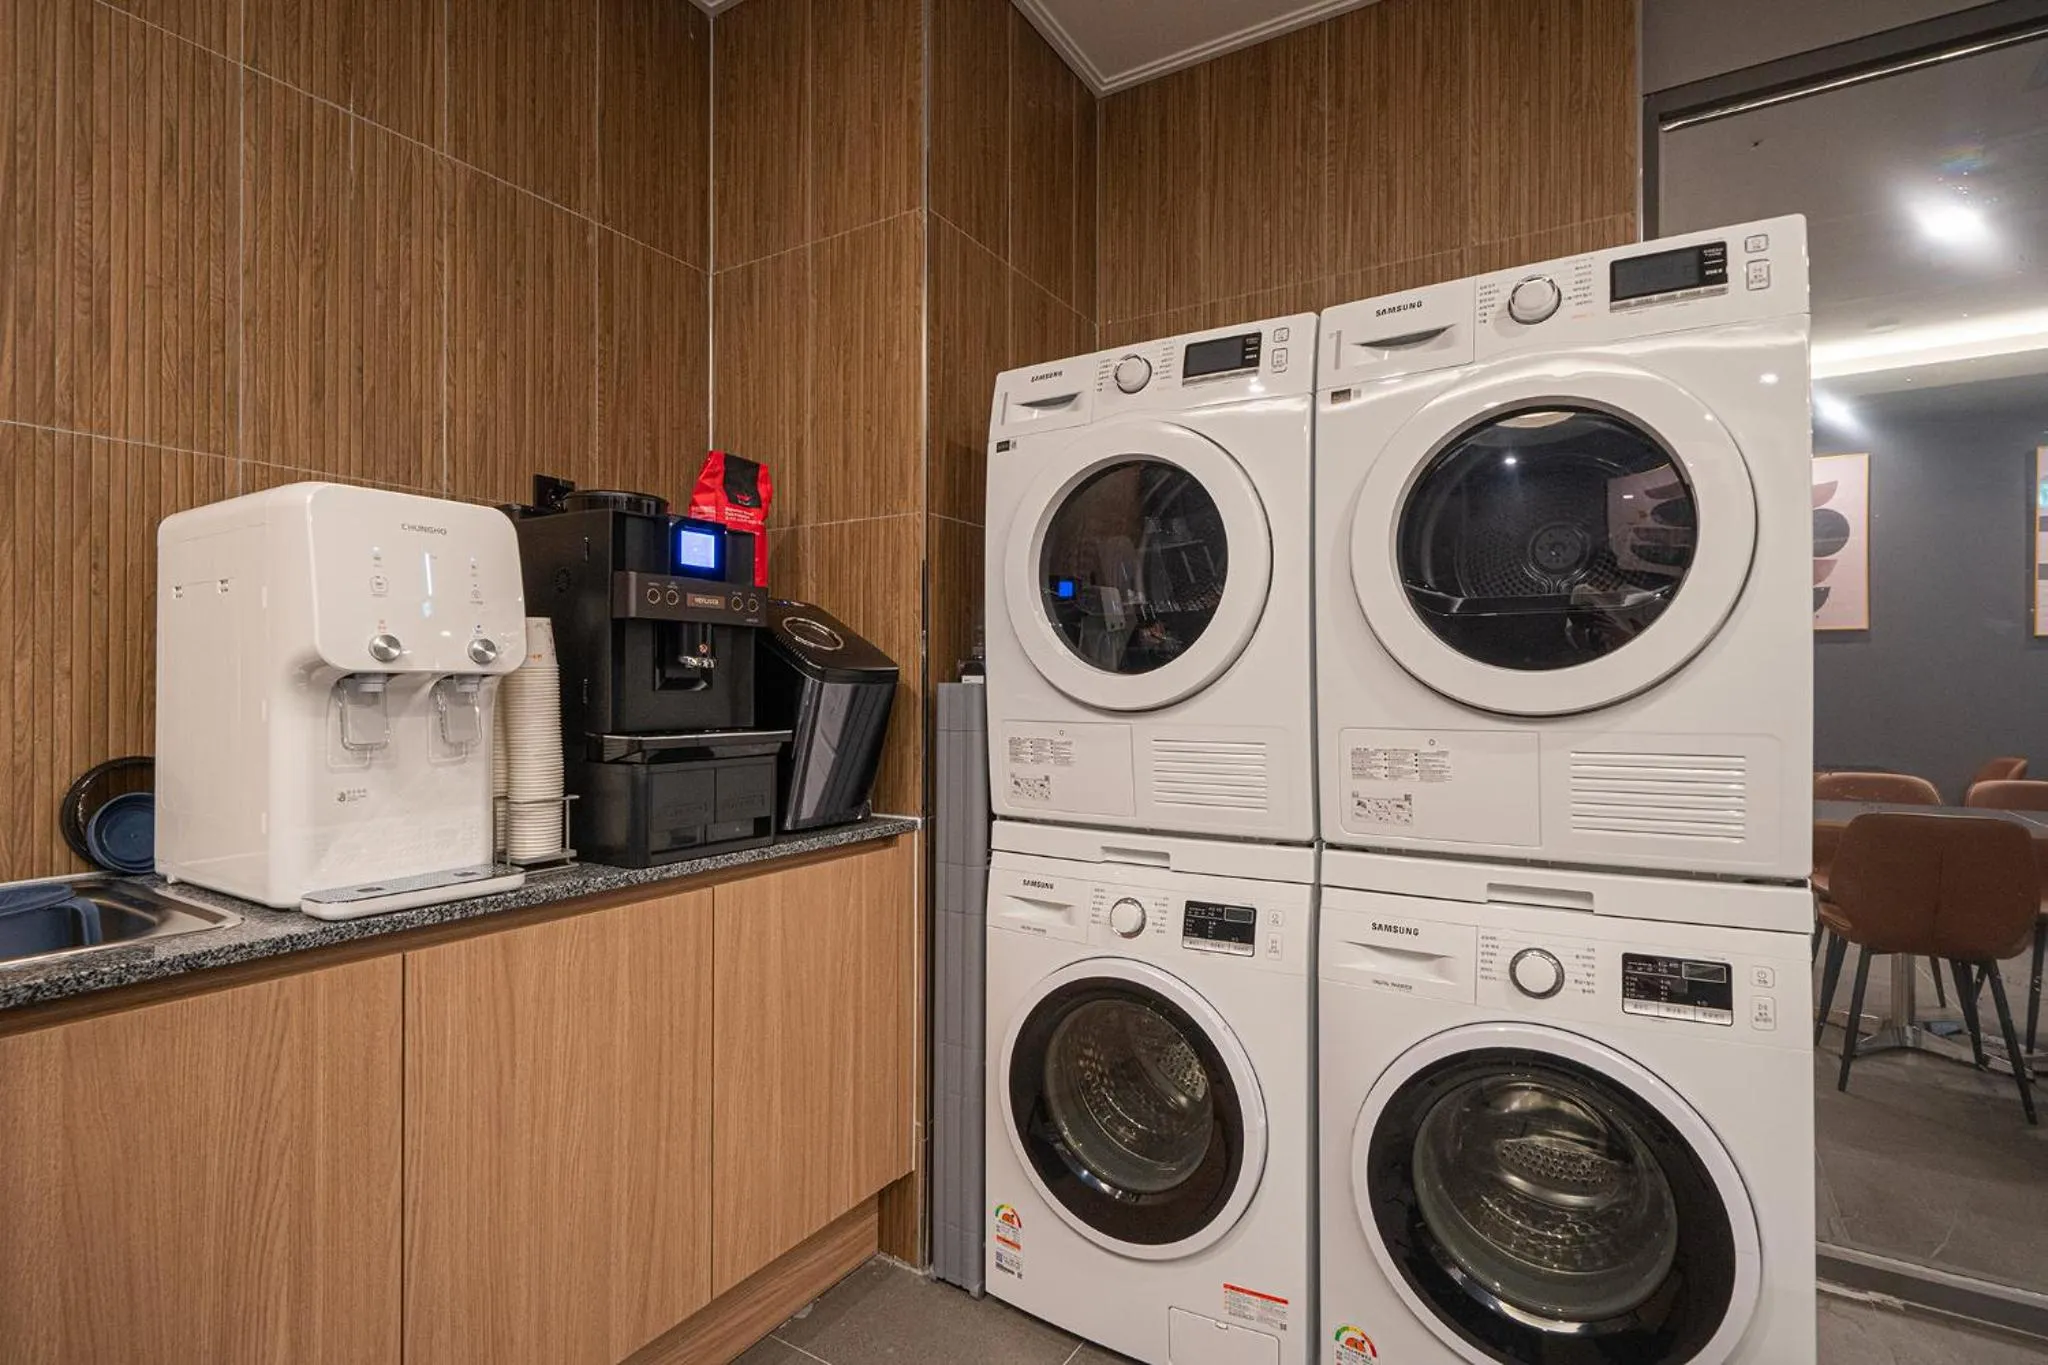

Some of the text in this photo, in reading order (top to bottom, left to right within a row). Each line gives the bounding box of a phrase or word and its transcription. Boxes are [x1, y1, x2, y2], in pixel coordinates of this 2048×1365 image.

[1375, 300, 1423, 317] SAMSUNG
[1031, 370, 1063, 382] SAMSUNG
[401, 523, 448, 535] CHUNGHO
[1022, 878, 1055, 890] SAMSUNG
[1371, 922, 1420, 936] SAMSUNG
